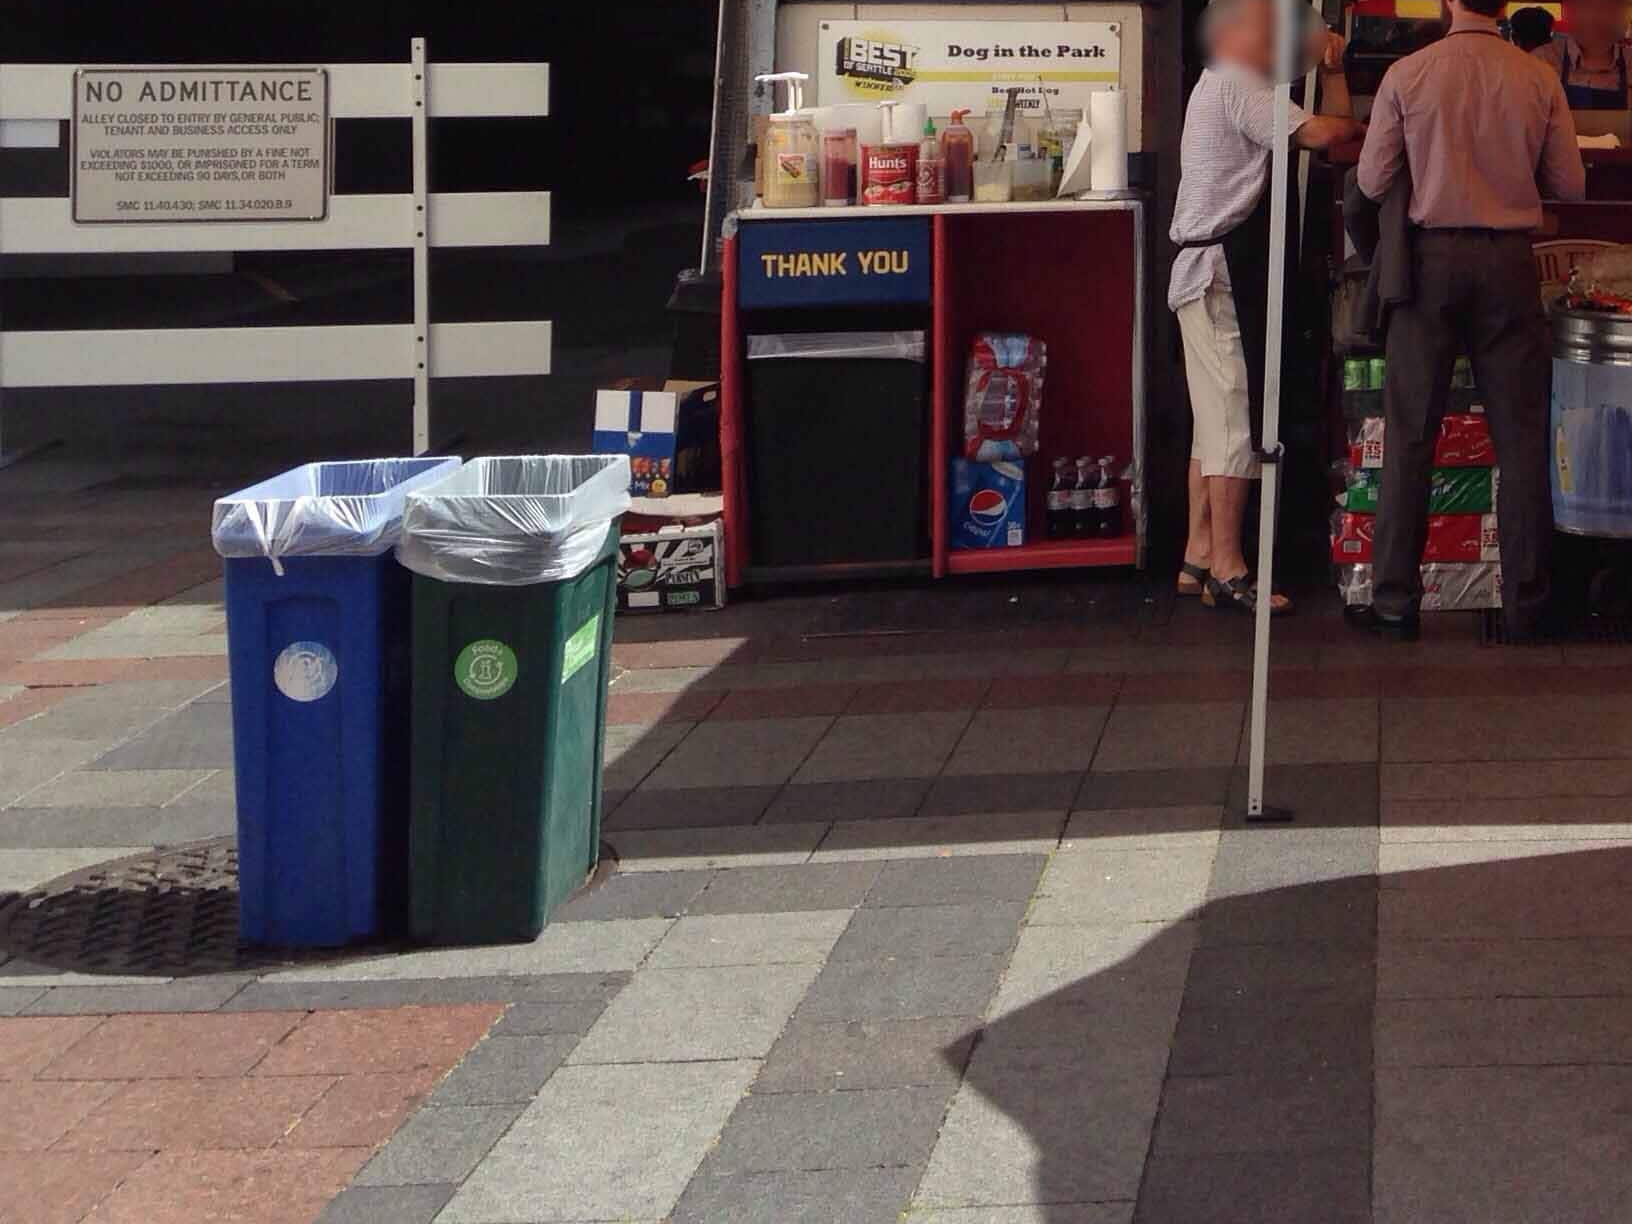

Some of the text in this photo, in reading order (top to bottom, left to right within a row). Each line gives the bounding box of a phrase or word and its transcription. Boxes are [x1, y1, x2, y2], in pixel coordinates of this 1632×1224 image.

[850, 38, 920, 69] BEST
[948, 45, 1105, 60] Dog in the Park
[86, 80, 312, 102] NO ADMITTANCE
[81, 113, 114, 124] ALLEY
[117, 113, 159, 124] CLOSED
[160, 113, 174, 124] TO
[177, 113, 211, 124] ENTRY
[214, 113, 226, 123] BY
[230, 112, 277, 123] GENERAL
[104, 125, 298, 136] TENANT AND BUSINESS ACCESS ONLY
[89, 147, 311, 159] VIOLATORS MAY BE PUNISHED BY A FINE NOT
[80, 160, 137, 170] EXCEEDING
[177, 160, 192, 169] OR
[194, 160, 257, 169] IMPRISONED
[260, 159, 279, 169] FOR
[282, 159, 289, 169] A
[290, 159, 320, 169] TERM
[115, 171, 136, 181] NOT
[137, 171, 194, 181] EXCEEDING
[258, 170, 286, 181] BOTH
[116, 200, 140, 211] SMC
[198, 200, 222, 210] SMC
[761, 250, 909, 279] THANK YOU
